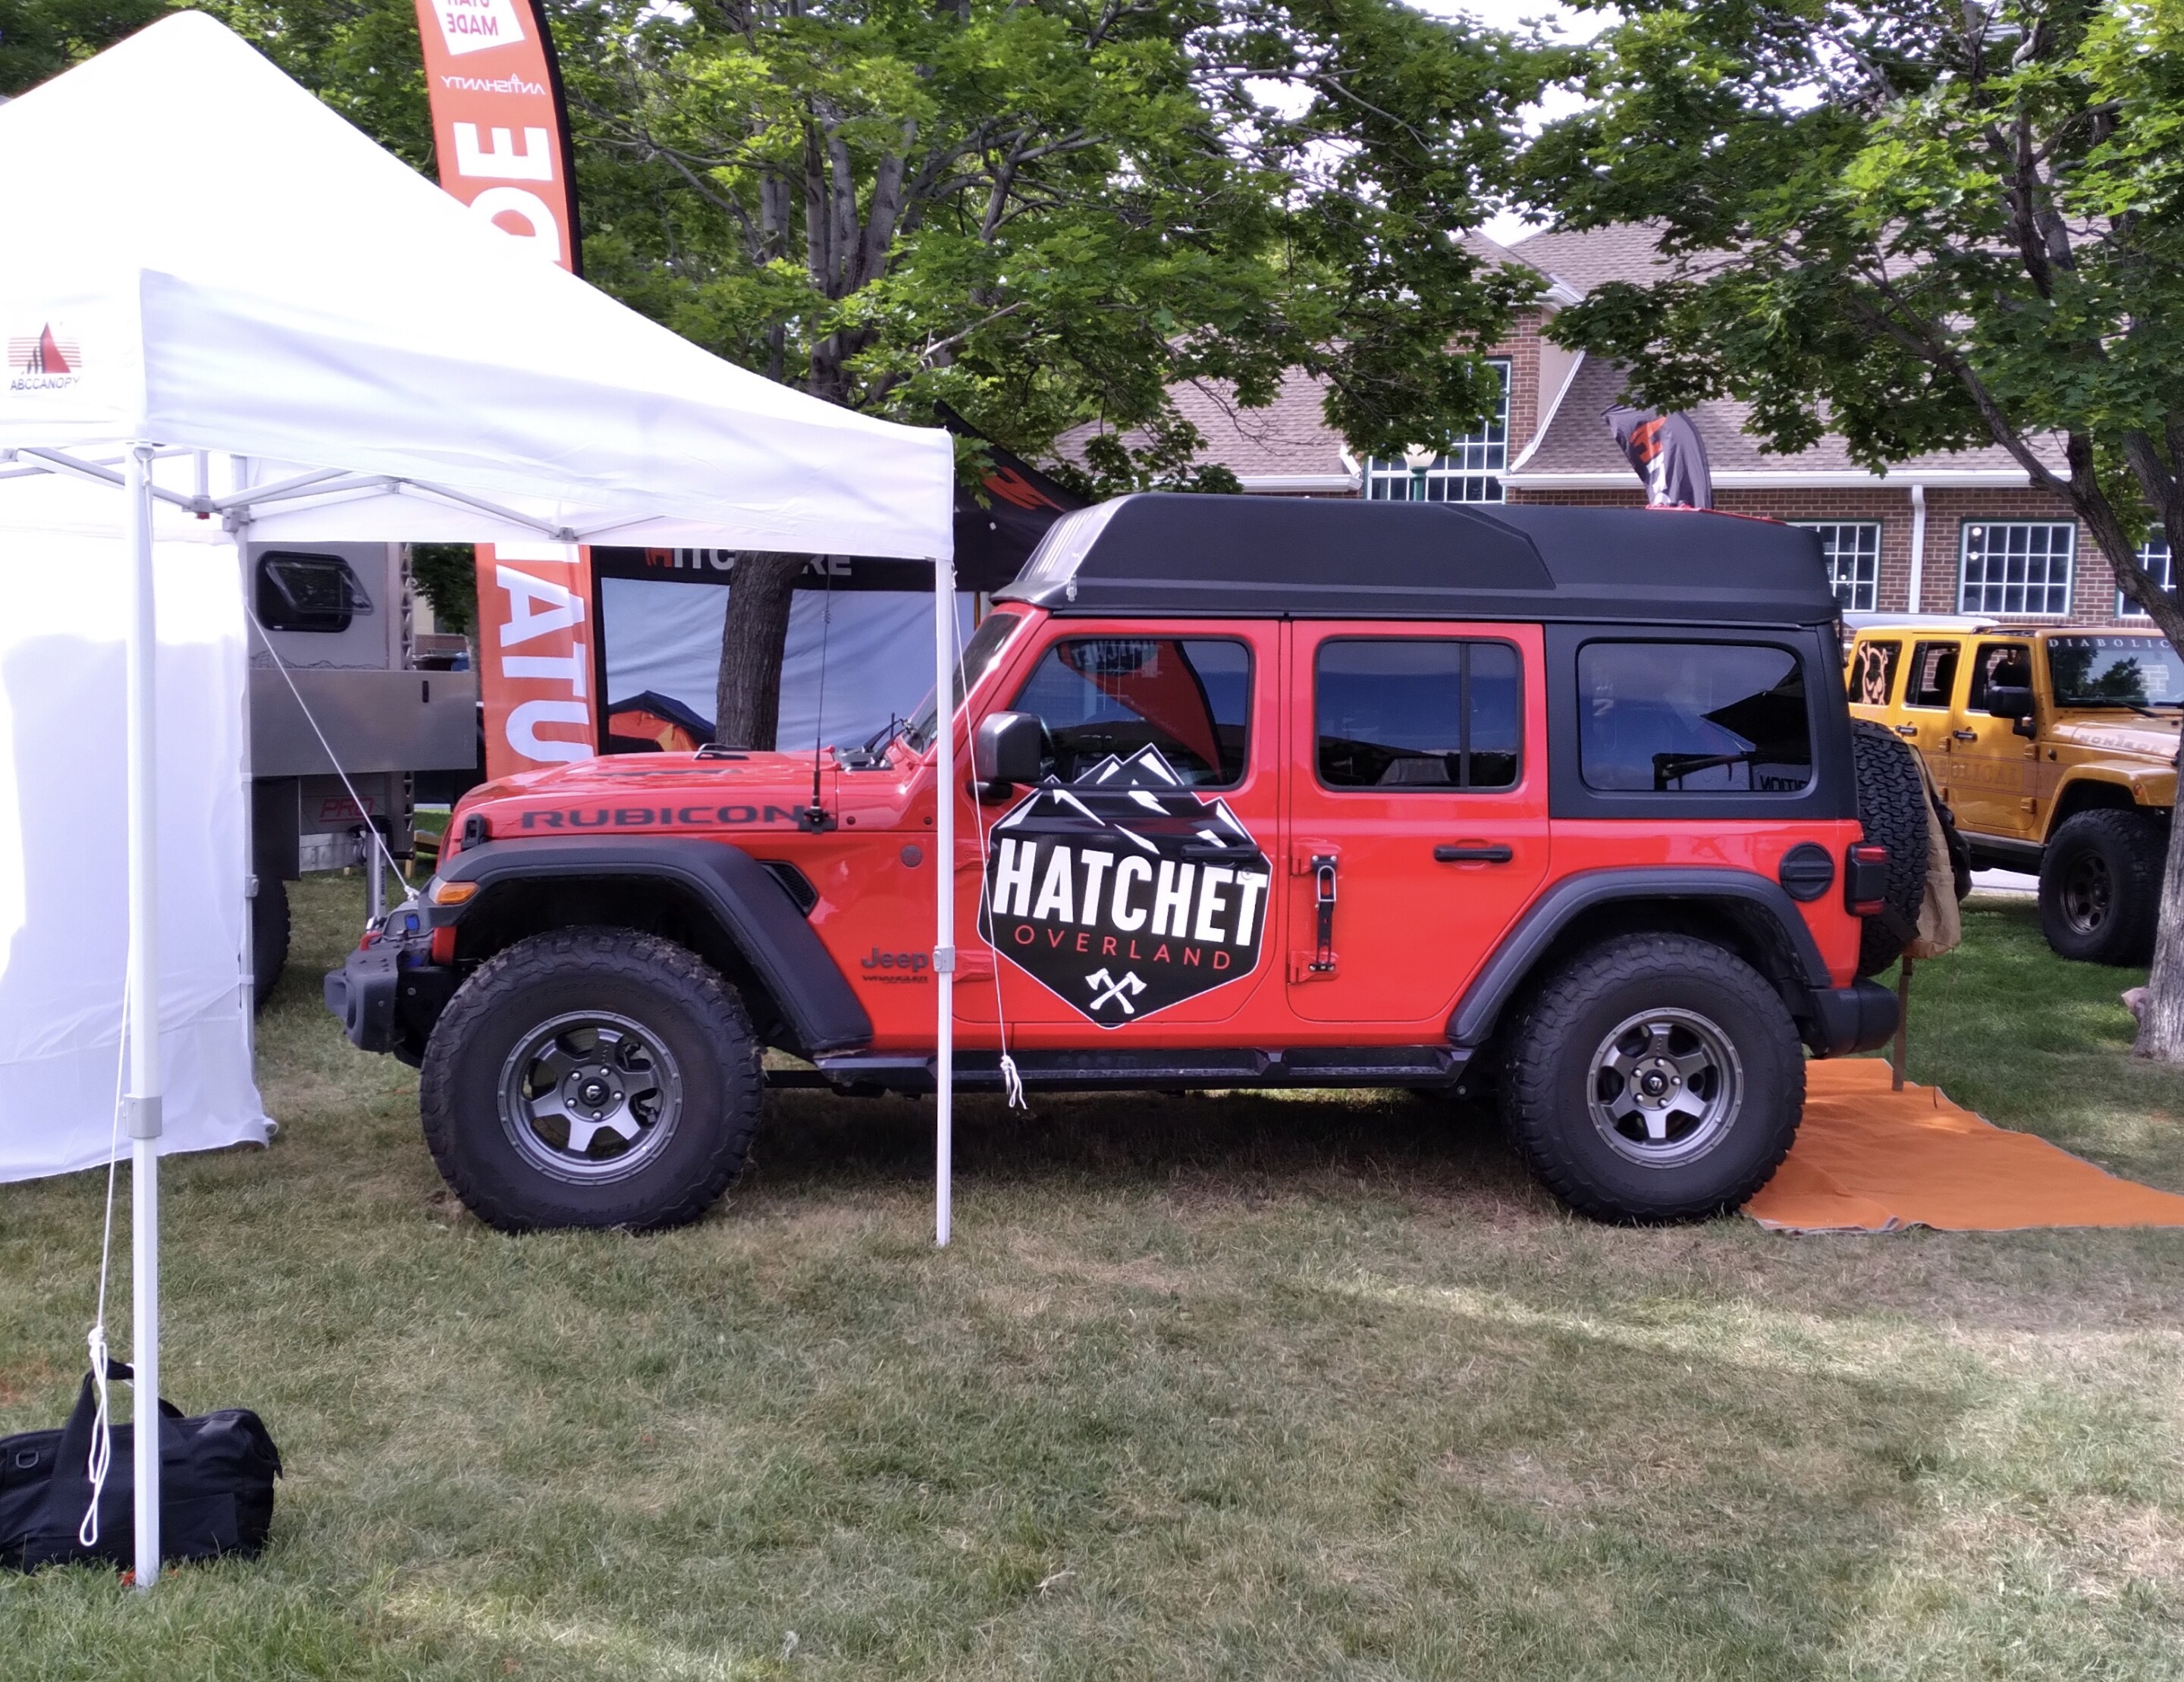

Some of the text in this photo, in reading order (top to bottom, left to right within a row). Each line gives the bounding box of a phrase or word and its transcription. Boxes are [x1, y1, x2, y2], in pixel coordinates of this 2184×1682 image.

[10, 377, 81, 391] ABCCANOPY
[319, 797, 375, 817] PRO
[522, 805, 805, 830] RUBICON
[993, 838, 1268, 946] HATCHET
[861, 946, 929, 973] Jeep
[1014, 924, 1231, 971] OVERLAND
